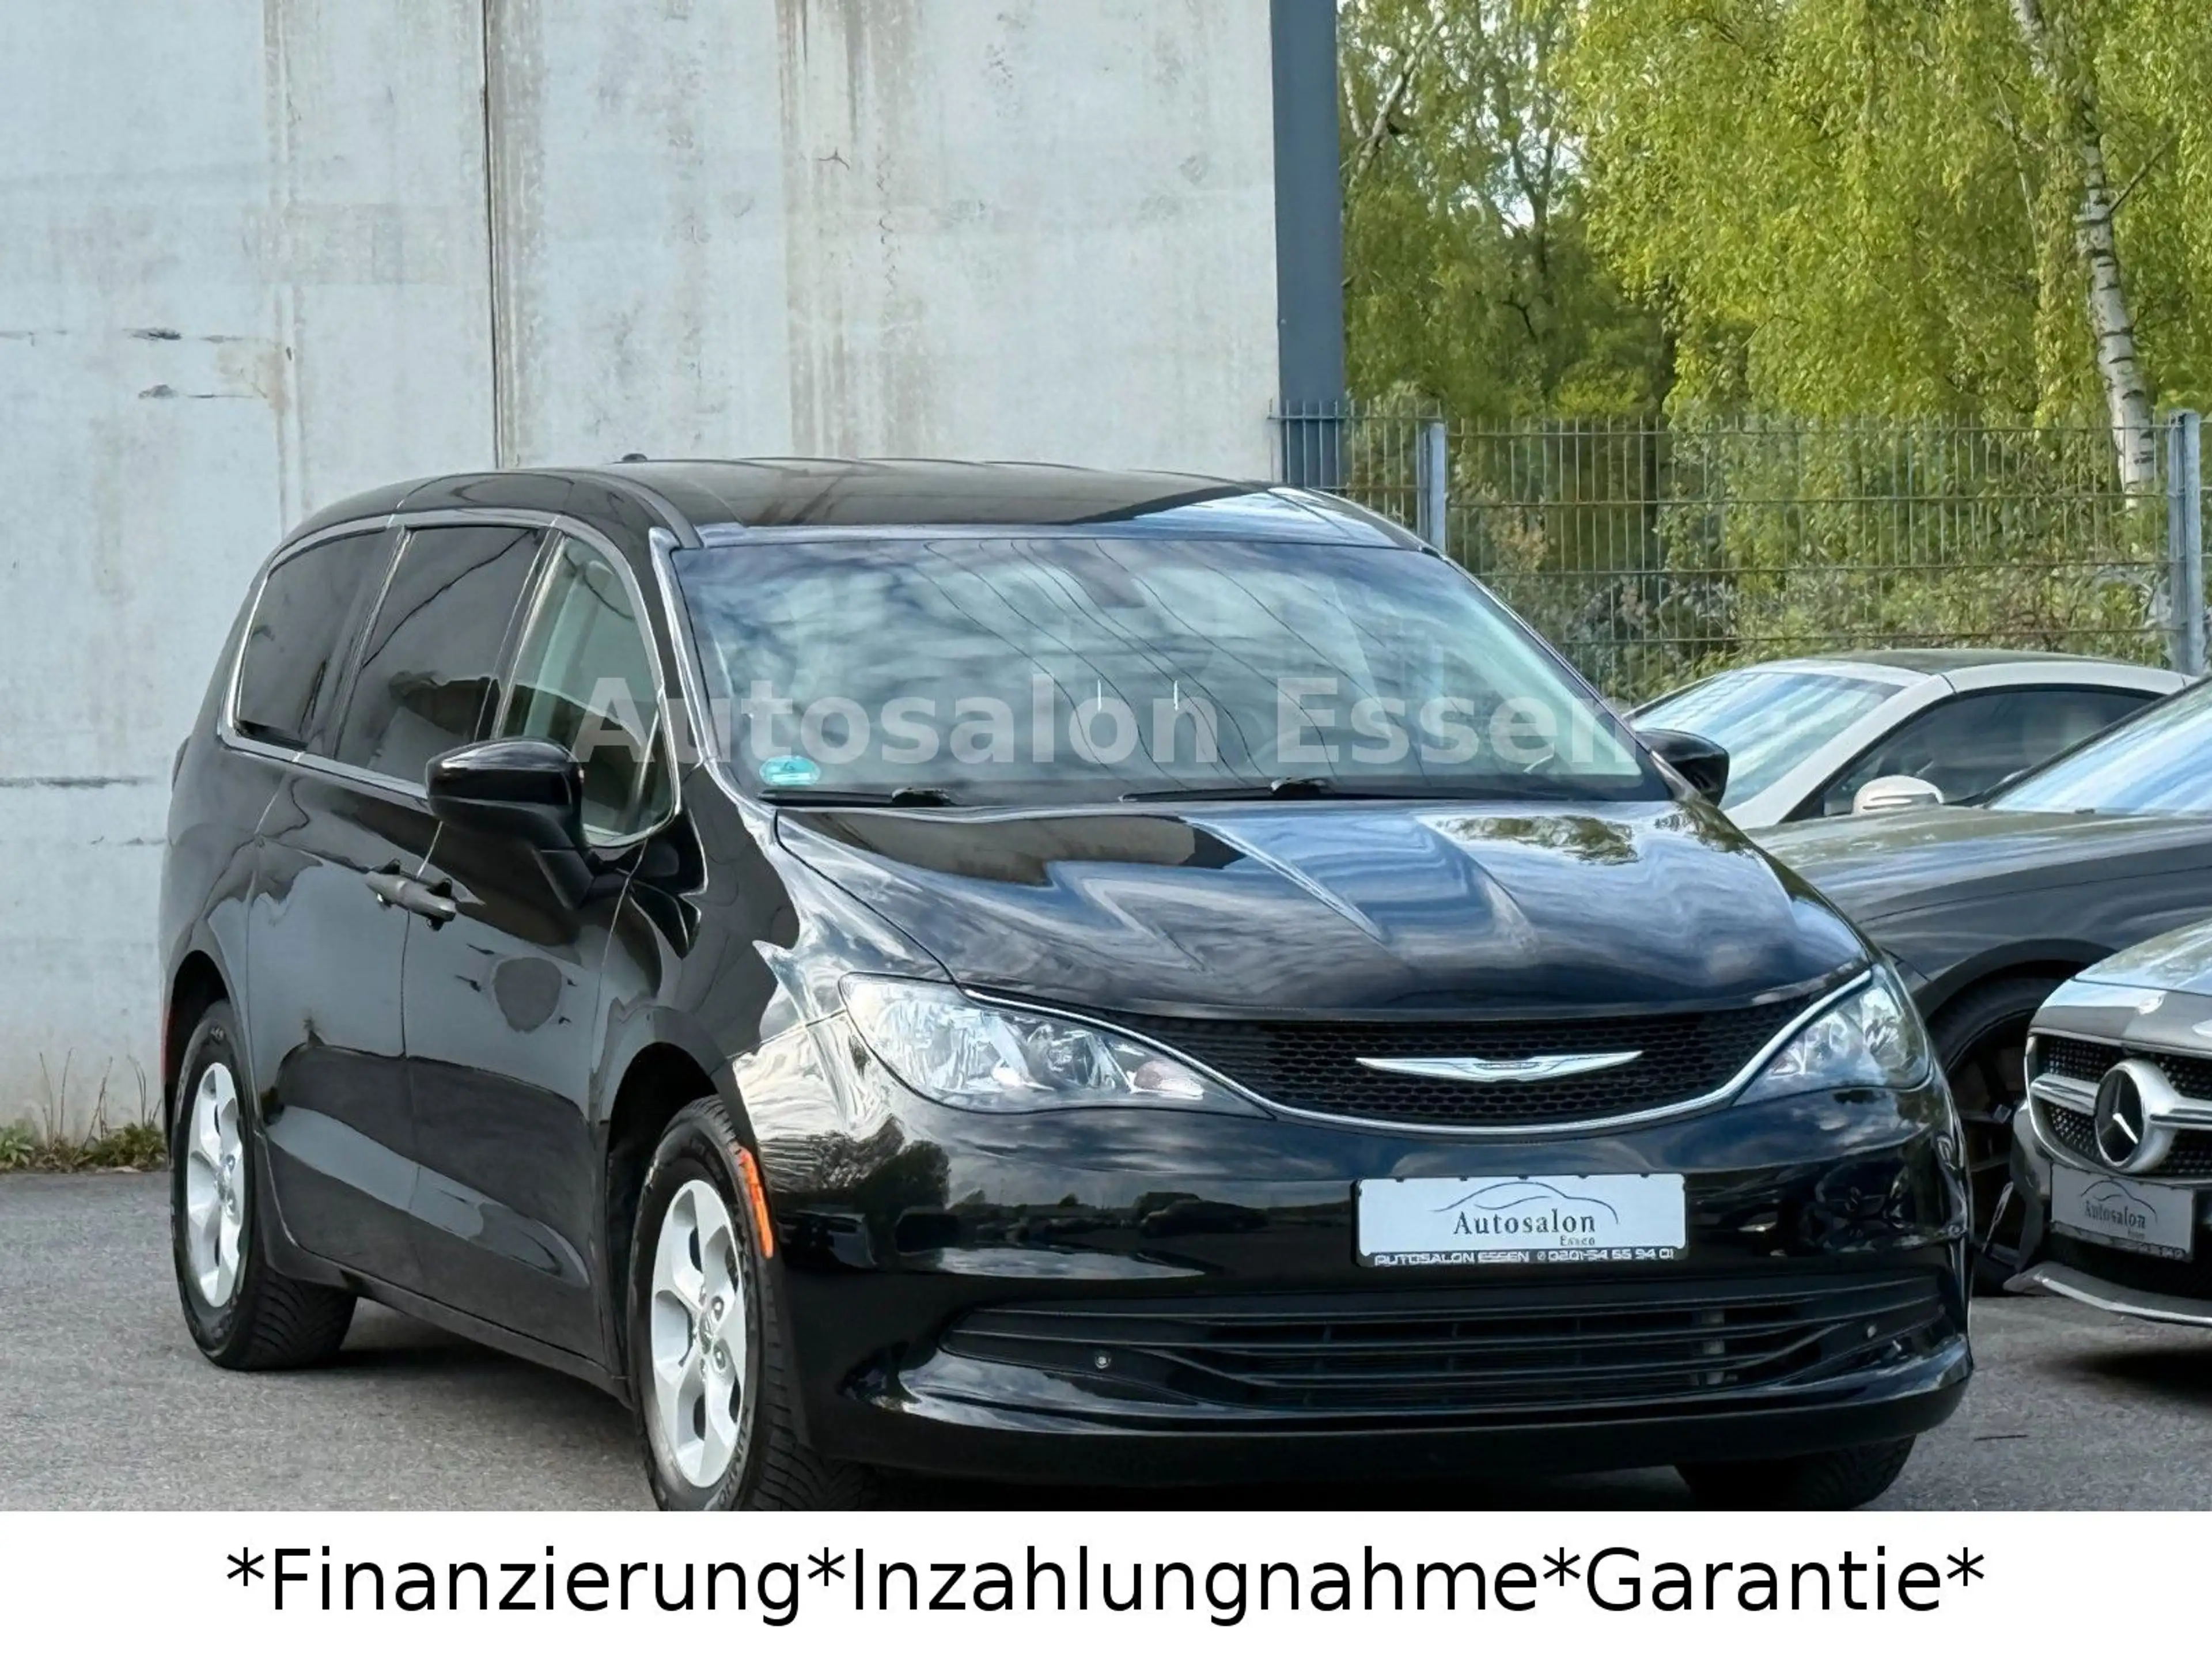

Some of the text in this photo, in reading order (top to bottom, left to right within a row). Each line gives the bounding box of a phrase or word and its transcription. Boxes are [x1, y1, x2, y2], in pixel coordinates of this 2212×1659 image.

[1453, 1208, 1596, 1235] Autosalon
[1374, 1252, 1475, 1266] AUTOSALON
[1477, 1251, 1529, 1263] ESSEN
